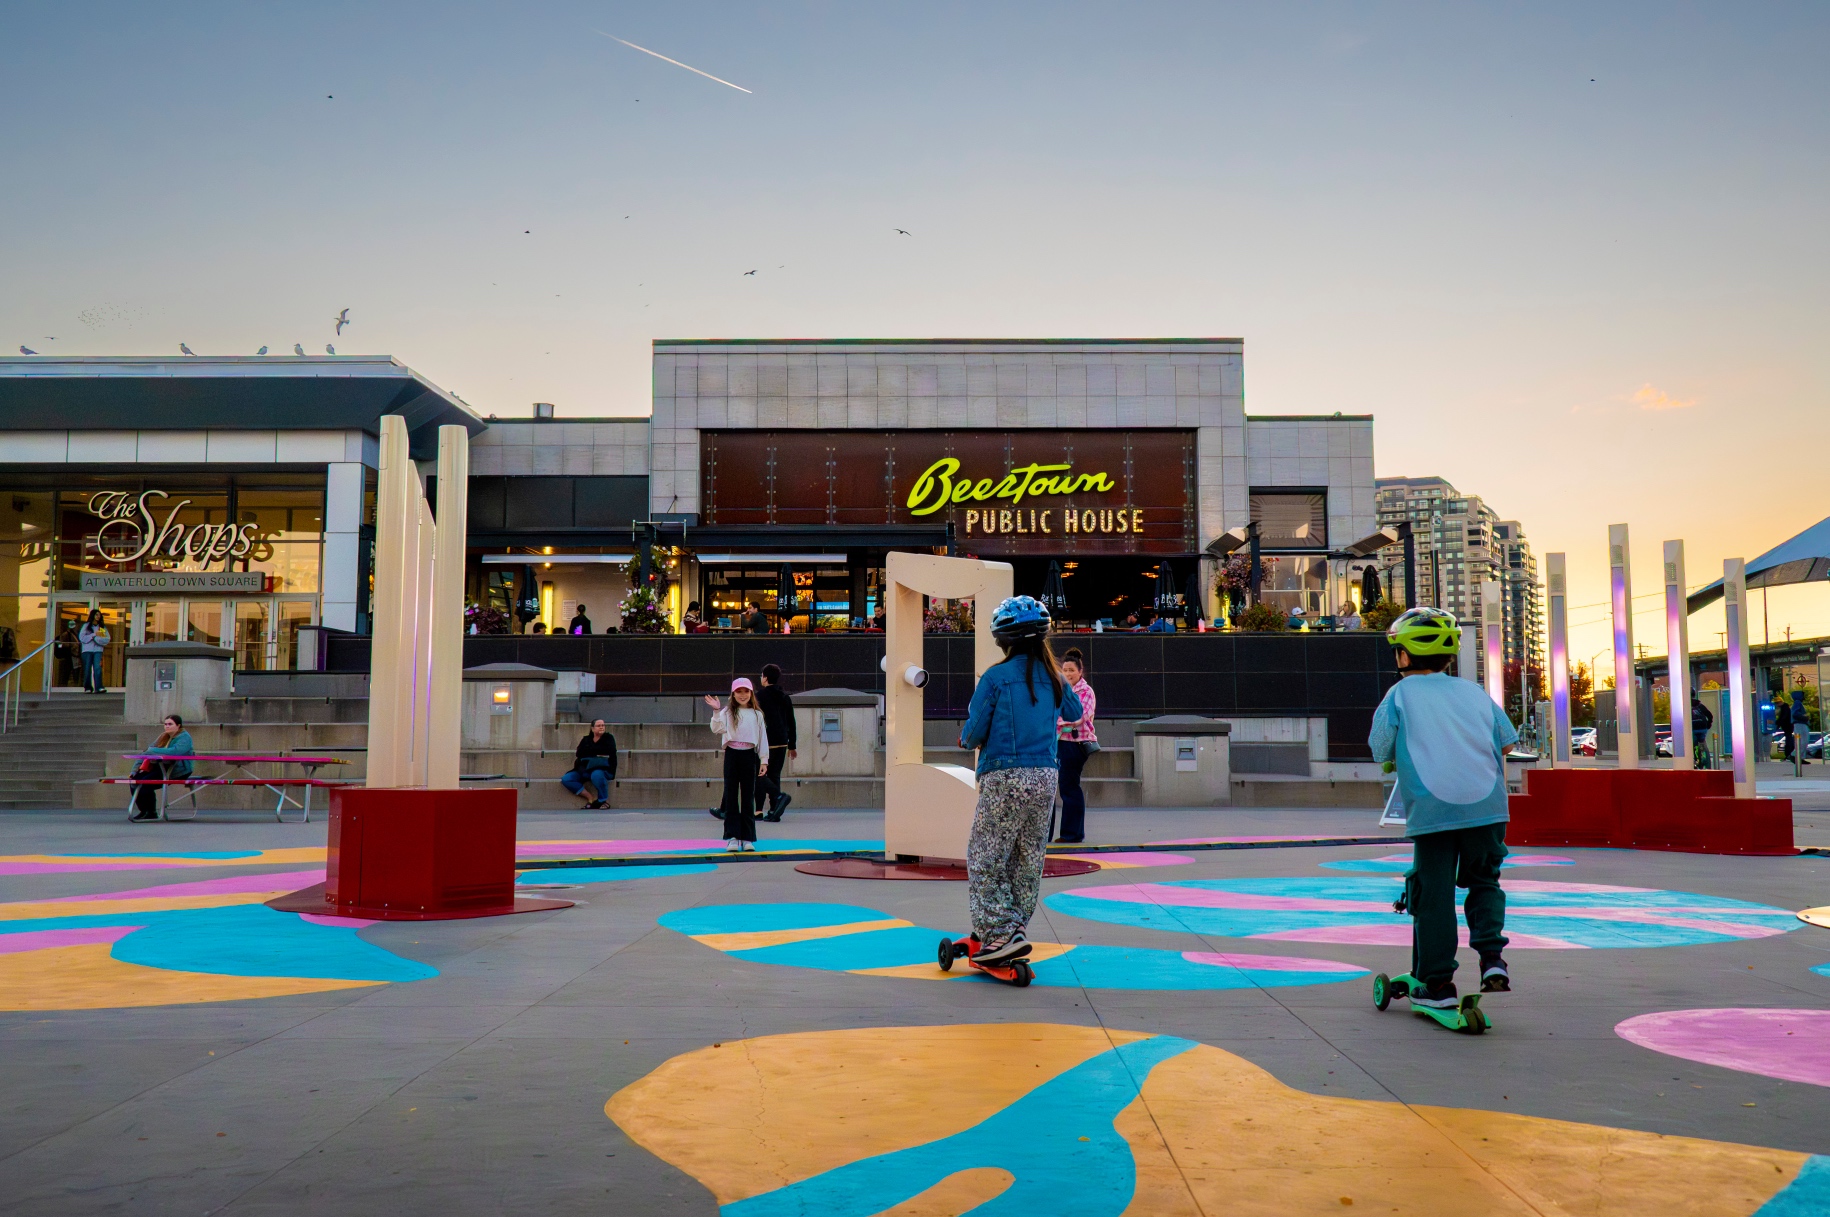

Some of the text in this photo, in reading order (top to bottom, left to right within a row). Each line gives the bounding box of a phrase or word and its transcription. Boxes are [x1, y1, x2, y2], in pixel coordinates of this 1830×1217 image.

[88, 490, 259, 571] The Shops
[965, 509, 1145, 534] PUBLIC HOUSE
[85, 577, 258, 587] AT WATERLOO TOWN SQUARE
